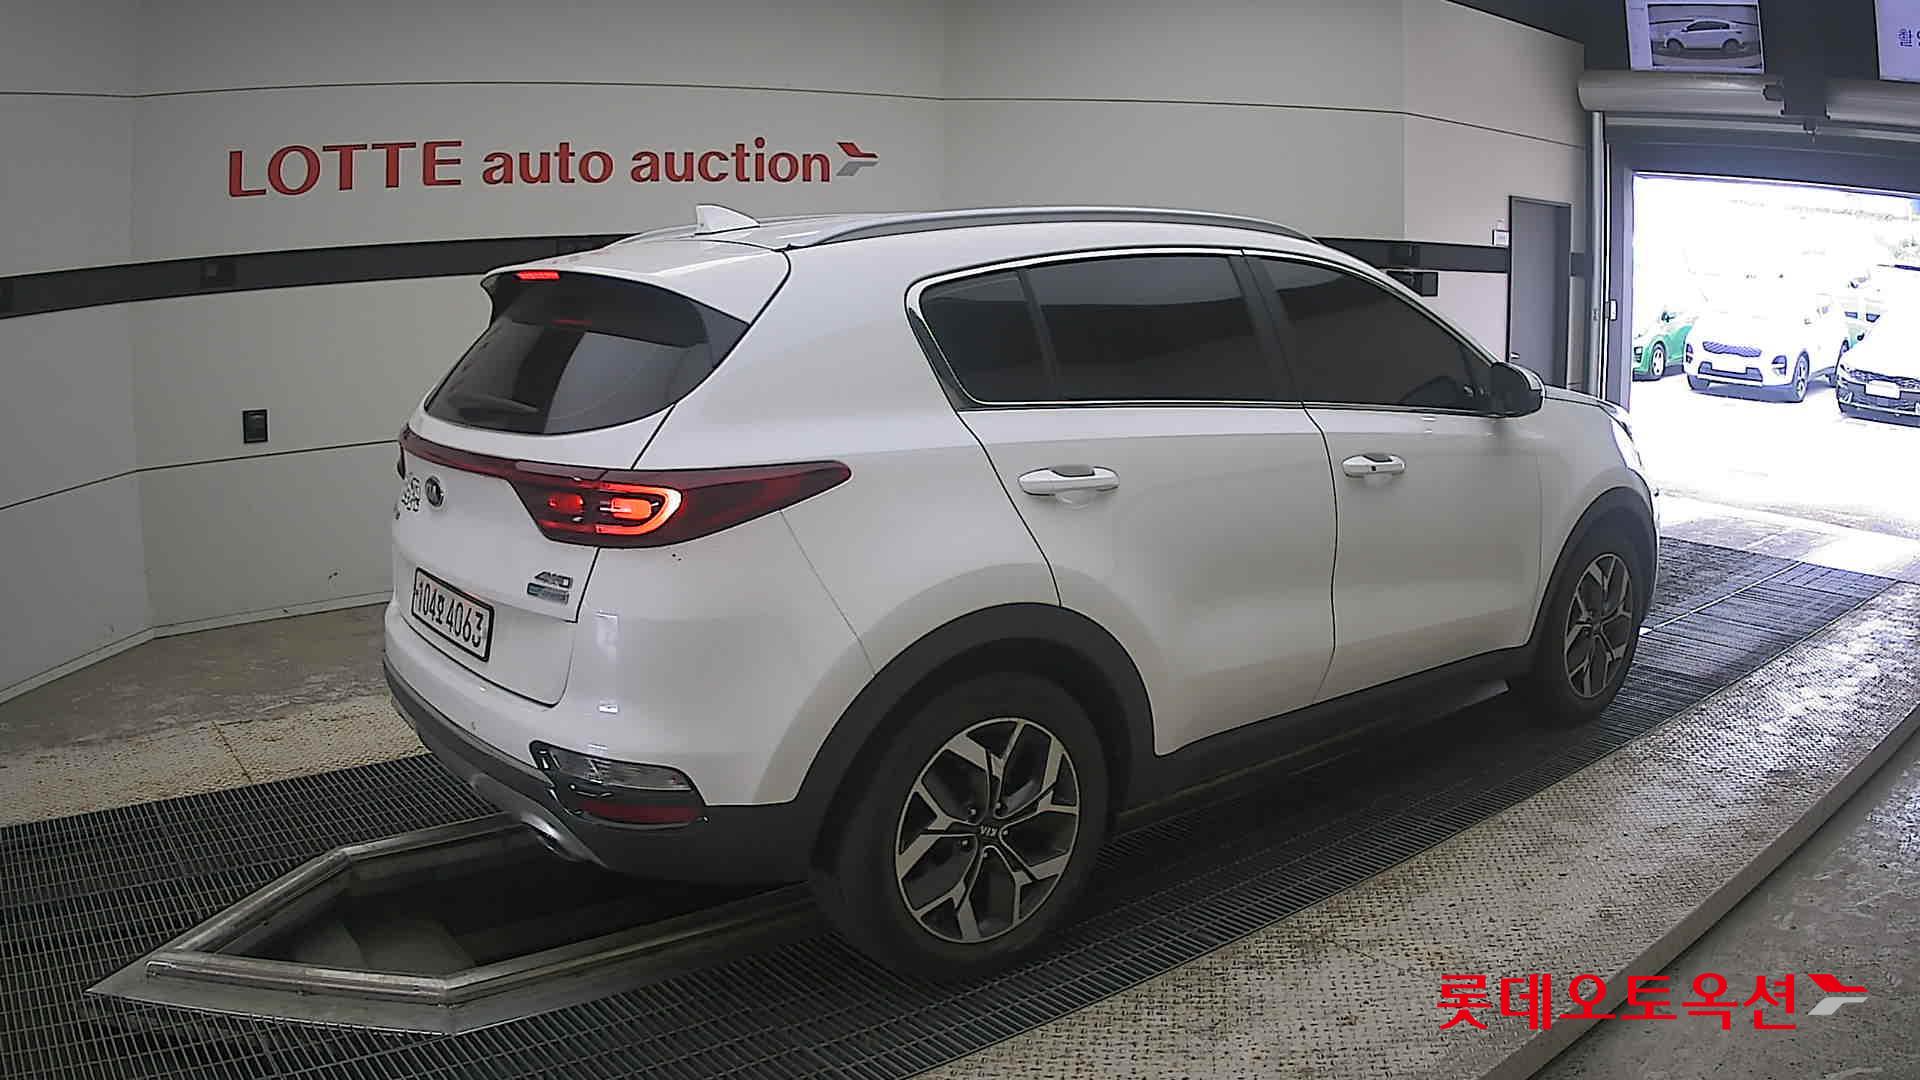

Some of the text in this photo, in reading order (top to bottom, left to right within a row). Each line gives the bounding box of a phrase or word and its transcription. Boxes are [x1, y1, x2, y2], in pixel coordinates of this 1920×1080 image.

[227, 137, 831, 198] LOTTE auto auction
[445, 599, 484, 648] 4063
